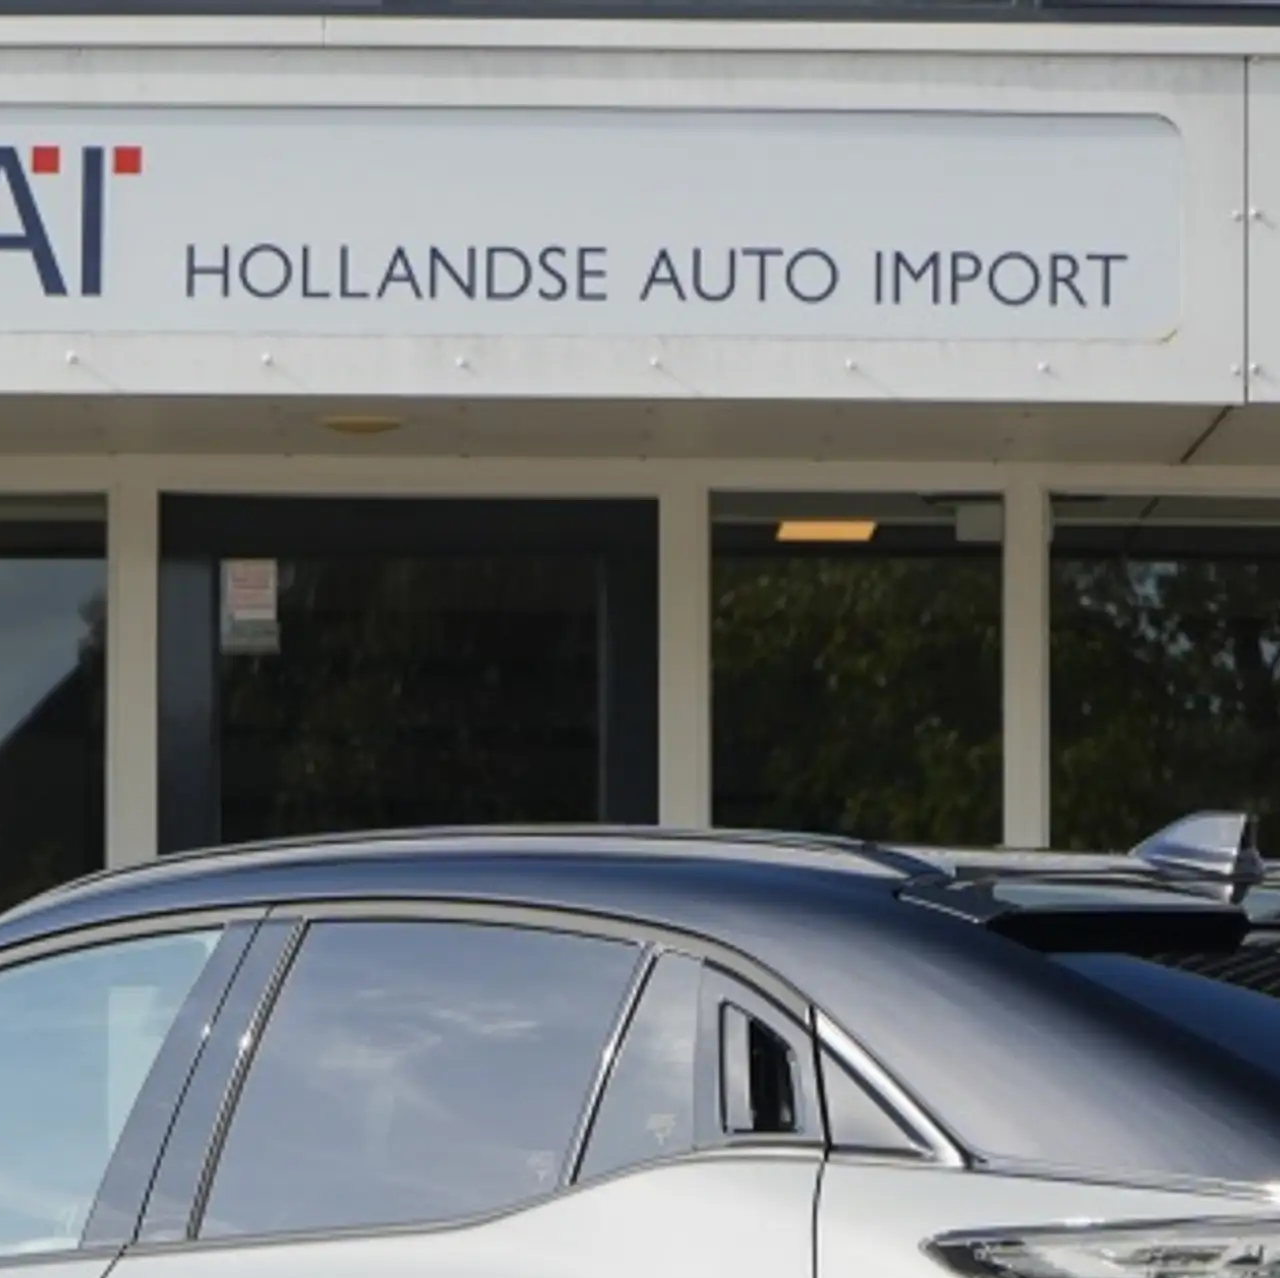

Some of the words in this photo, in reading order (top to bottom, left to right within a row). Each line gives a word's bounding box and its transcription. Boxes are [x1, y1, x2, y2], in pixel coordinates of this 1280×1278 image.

[185, 244, 608, 301] HOLLANDSE
[639, 248, 839, 303] AUTO
[874, 250, 1128, 307] IMPORT
